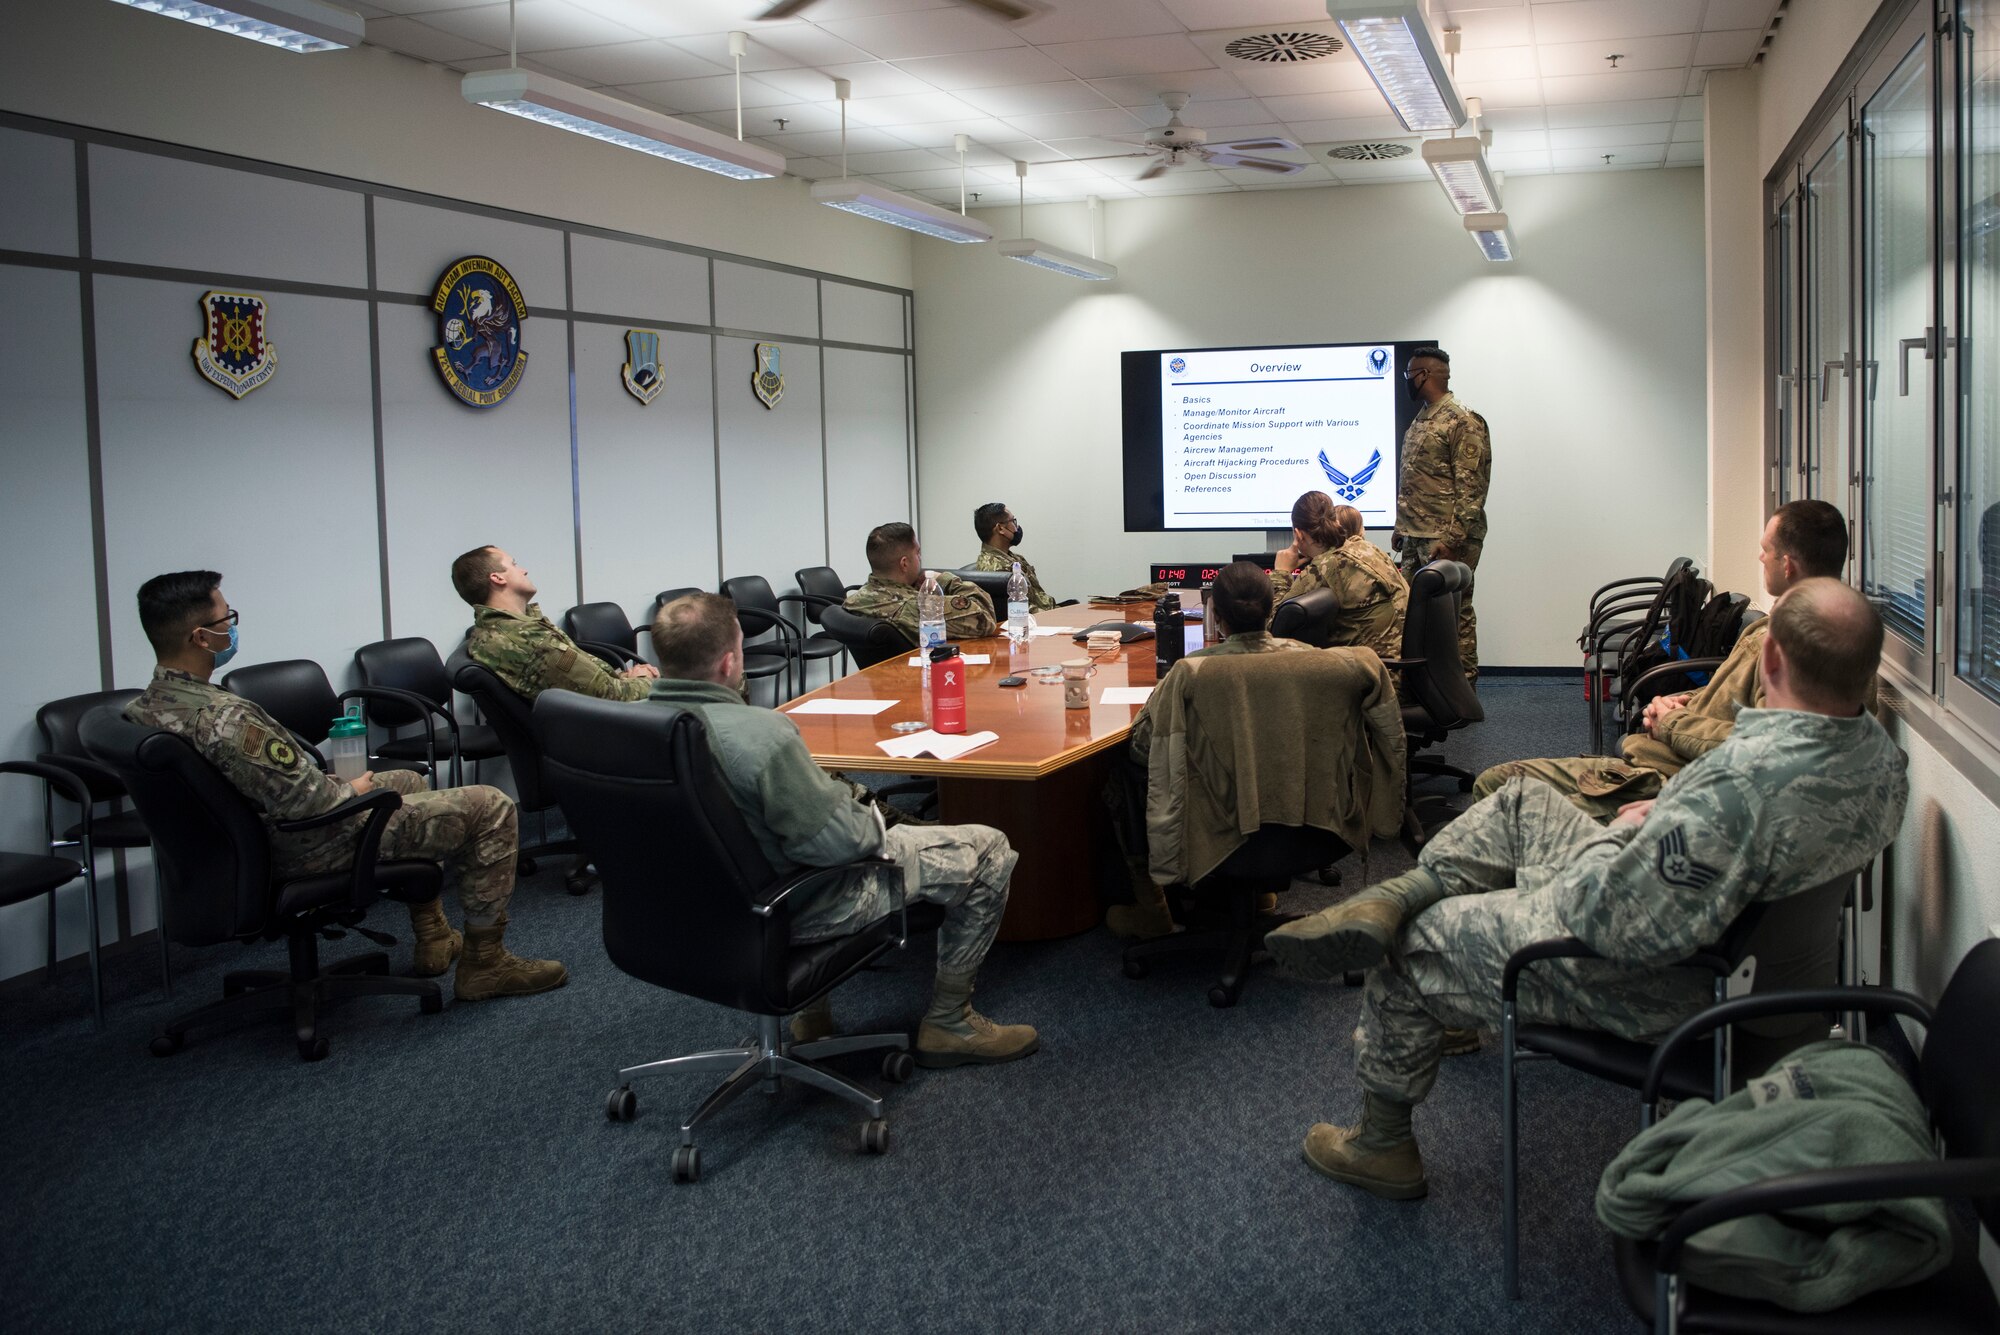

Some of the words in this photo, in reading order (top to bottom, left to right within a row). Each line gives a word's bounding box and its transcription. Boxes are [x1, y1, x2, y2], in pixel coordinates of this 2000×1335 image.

[436, 290, 447, 311] AUT
[444, 267, 461, 289] VIAM
[460, 259, 494, 273] INVENIAM
[494, 267, 509, 283] AUT
[506, 279, 526, 319] FACIAM
[1250, 363, 1302, 373] Overview
[202, 357, 214, 374] USAF
[212, 371, 257, 394] EXPEDITIONARY
[255, 360, 275, 383] CENTER
[453, 380, 478, 403] AERIAL
[479, 391, 497, 404] PORT
[498, 357, 525, 399] SQUADRON
[1183, 396, 1211, 404] Basics
[1183, 408, 1251, 418] Manage/Monitor
[1253, 407, 1286, 416] Aircraft
[1183, 422, 1230, 430] Coordinate
[1232, 421, 1266, 429] Mission
[1268, 420, 1303, 429] Support
[1306, 419, 1324, 427] with
[1326, 419, 1360, 427] Various
[1183, 433, 1223, 442] Agencies
[1184, 446, 1216, 454] Aircrew
[1218, 445, 1274, 455] Management
[1184, 459, 1216, 467] Aircraft
[1217, 458, 1257, 468] Hijacking
[1260, 457, 1310, 466] Procedures
[1184, 472, 1207, 481] Open
[1209, 472, 1257, 480] Discussion
[1184, 485, 1232, 493] References
[1159, 570, 1185, 579] 01:48
